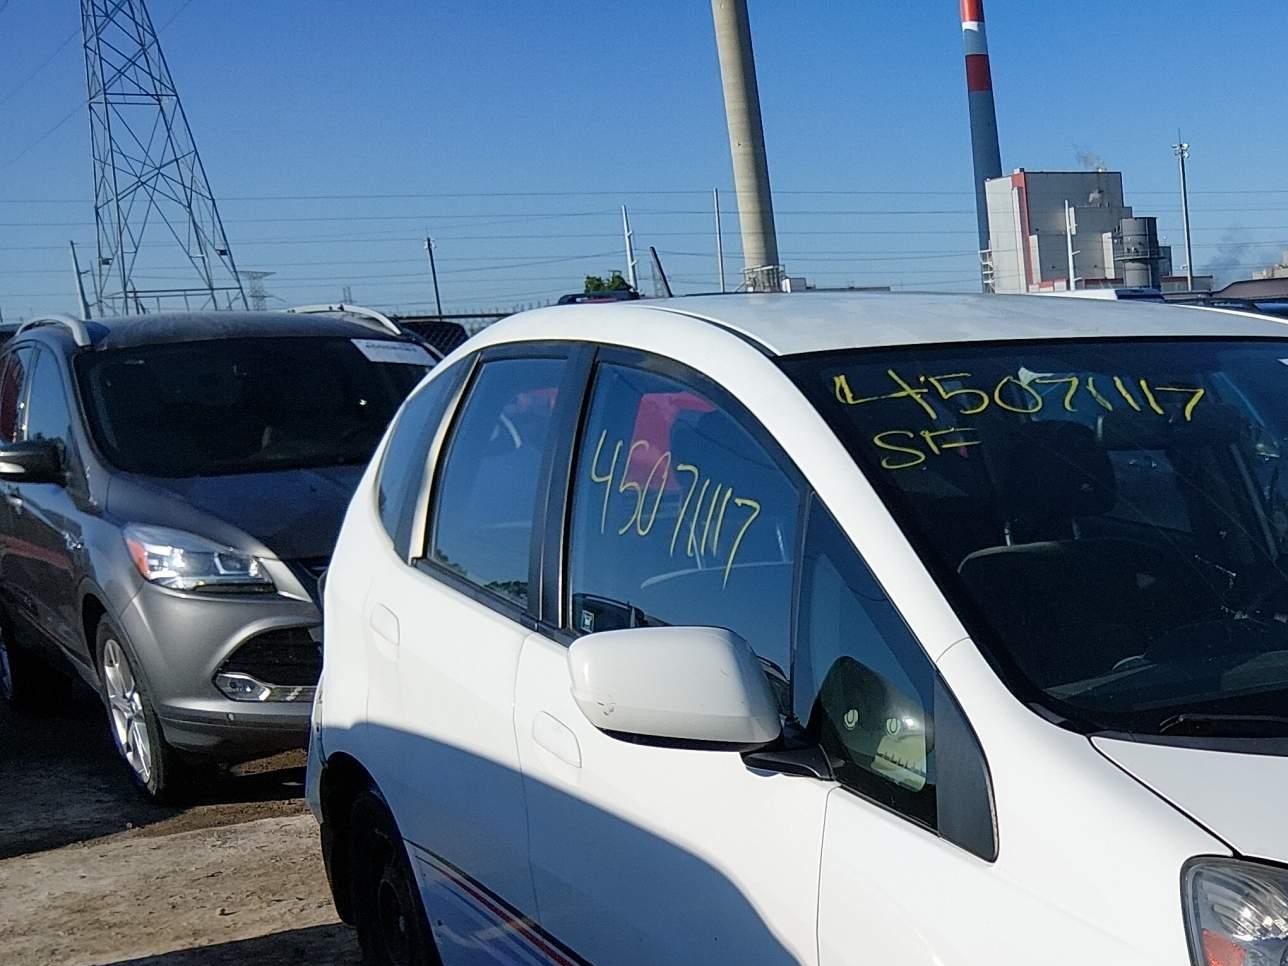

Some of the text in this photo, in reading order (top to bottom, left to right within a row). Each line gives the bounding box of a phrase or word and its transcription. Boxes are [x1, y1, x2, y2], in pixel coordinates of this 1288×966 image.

[834, 369, 1205, 422] 45071117
[873, 427, 982, 470] SF
[591, 429, 761, 591] 45071117
